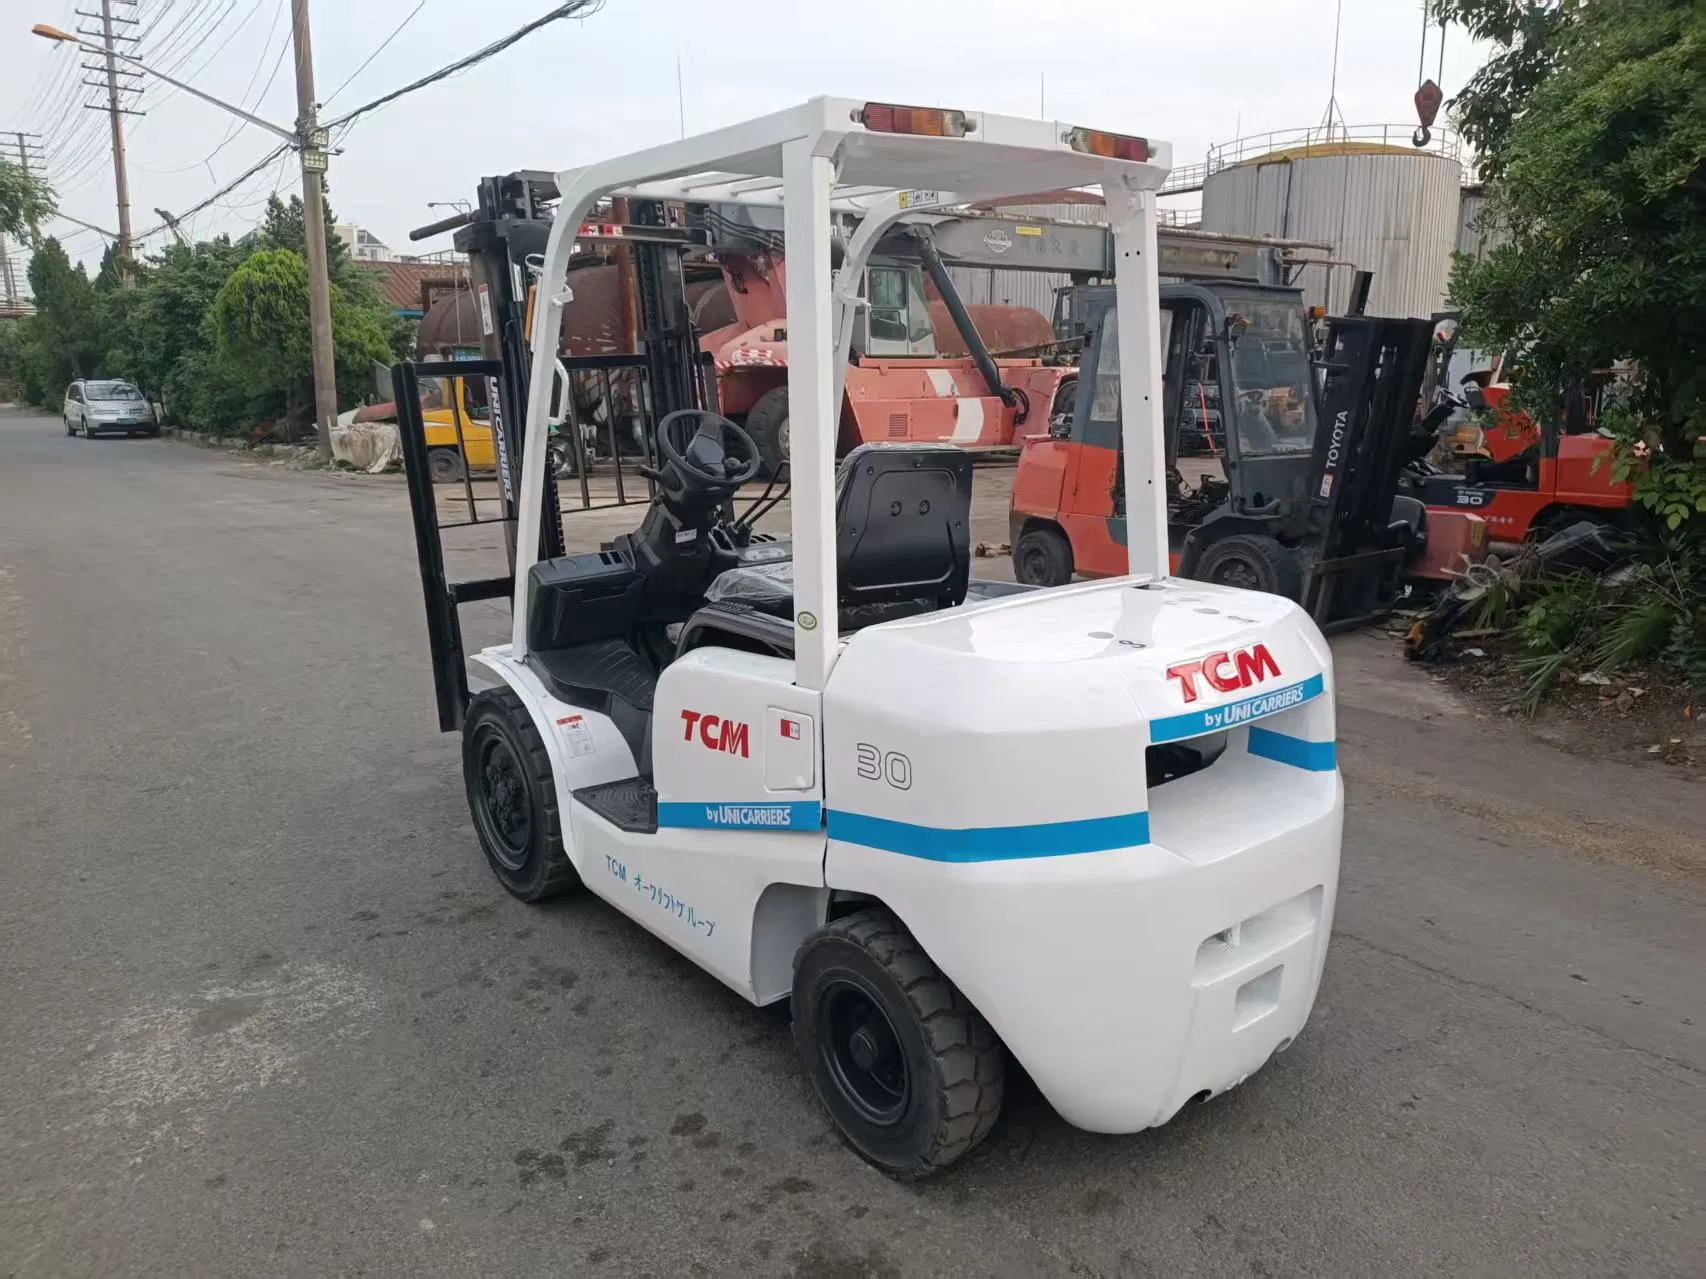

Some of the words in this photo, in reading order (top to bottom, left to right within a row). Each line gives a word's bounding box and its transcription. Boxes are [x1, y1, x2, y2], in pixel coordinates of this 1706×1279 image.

[1326, 410, 1348, 468] TOYOTA
[1456, 495, 1483, 505] 30
[1166, 644, 1282, 704] TCM
[680, 709, 749, 759] TCM
[1204, 712, 1223, 727] by
[856, 743, 912, 791] 30
[706, 806, 719, 823] by
[605, 854, 627, 881] TCM
